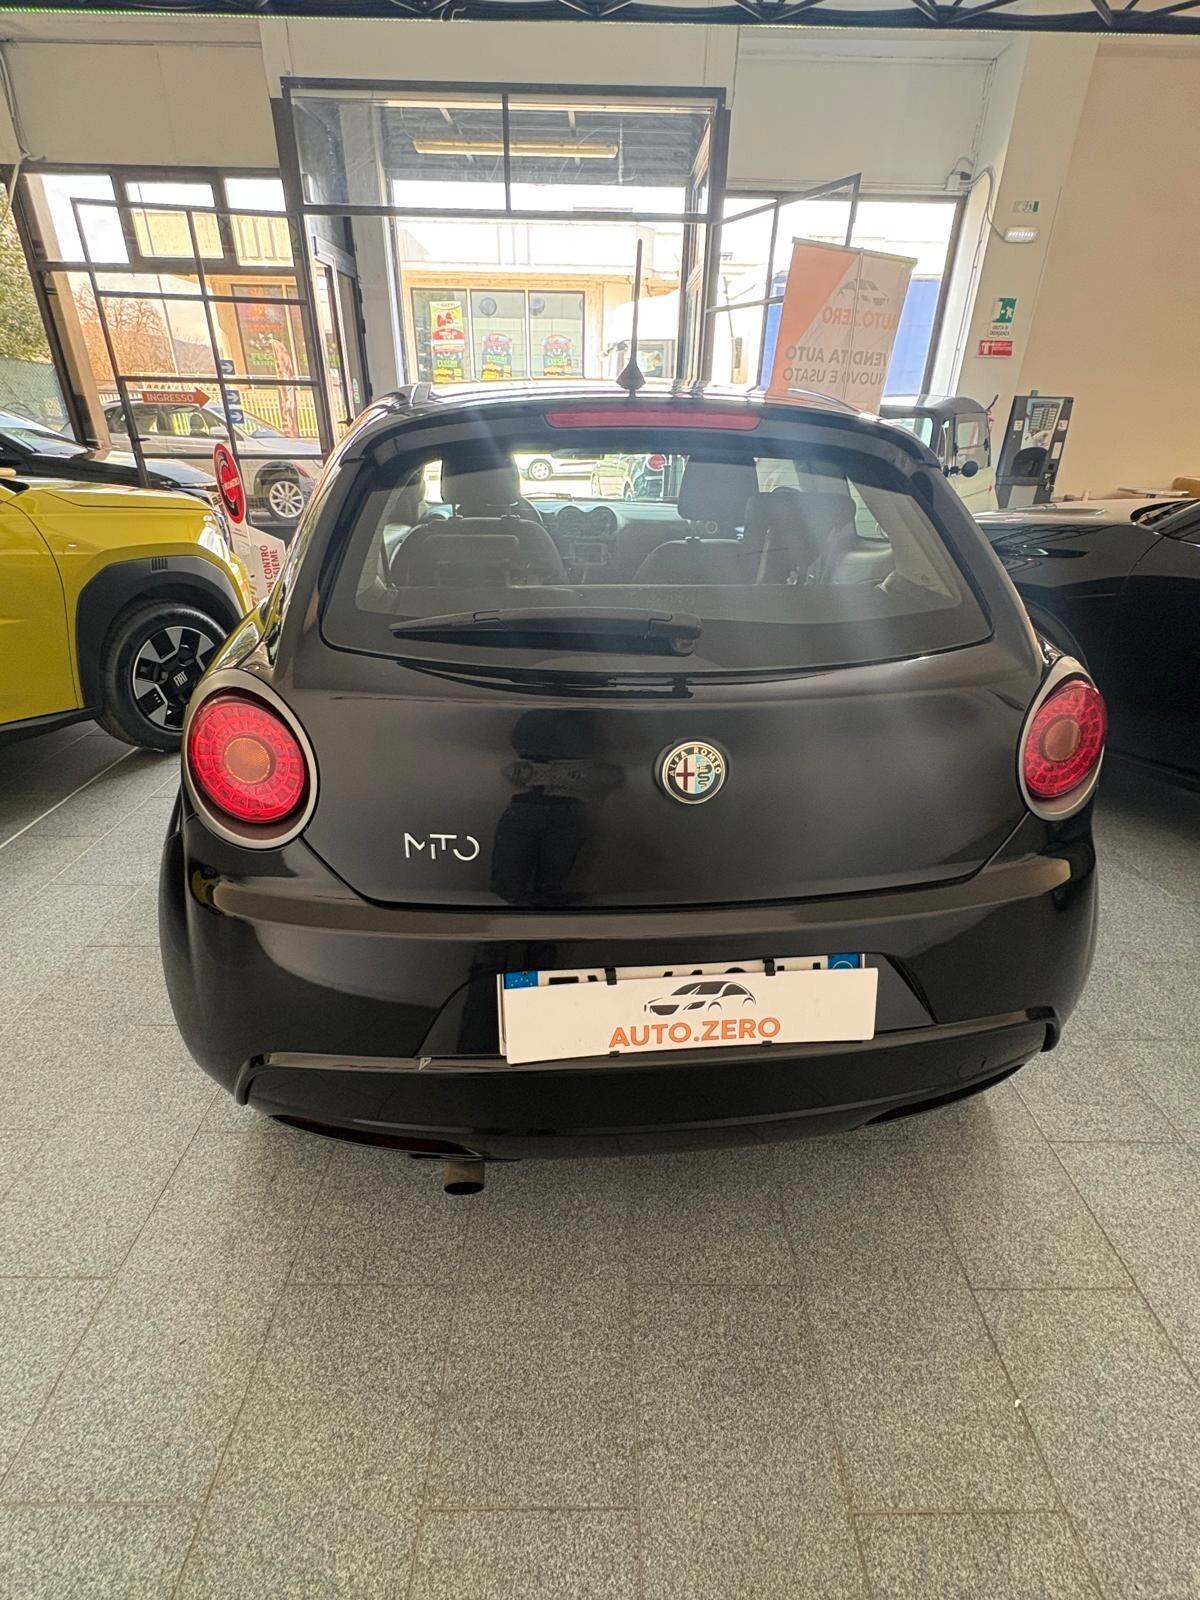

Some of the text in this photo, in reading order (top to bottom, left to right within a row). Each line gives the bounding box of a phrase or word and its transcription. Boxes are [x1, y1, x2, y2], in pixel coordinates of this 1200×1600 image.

[147, 393, 194, 402] INGRESSO
[260, 545, 273, 579] CONTRO
[668, 747, 722, 777] ALFA ROMEO
[609, 1016, 781, 1048] AUTO.ZERO
